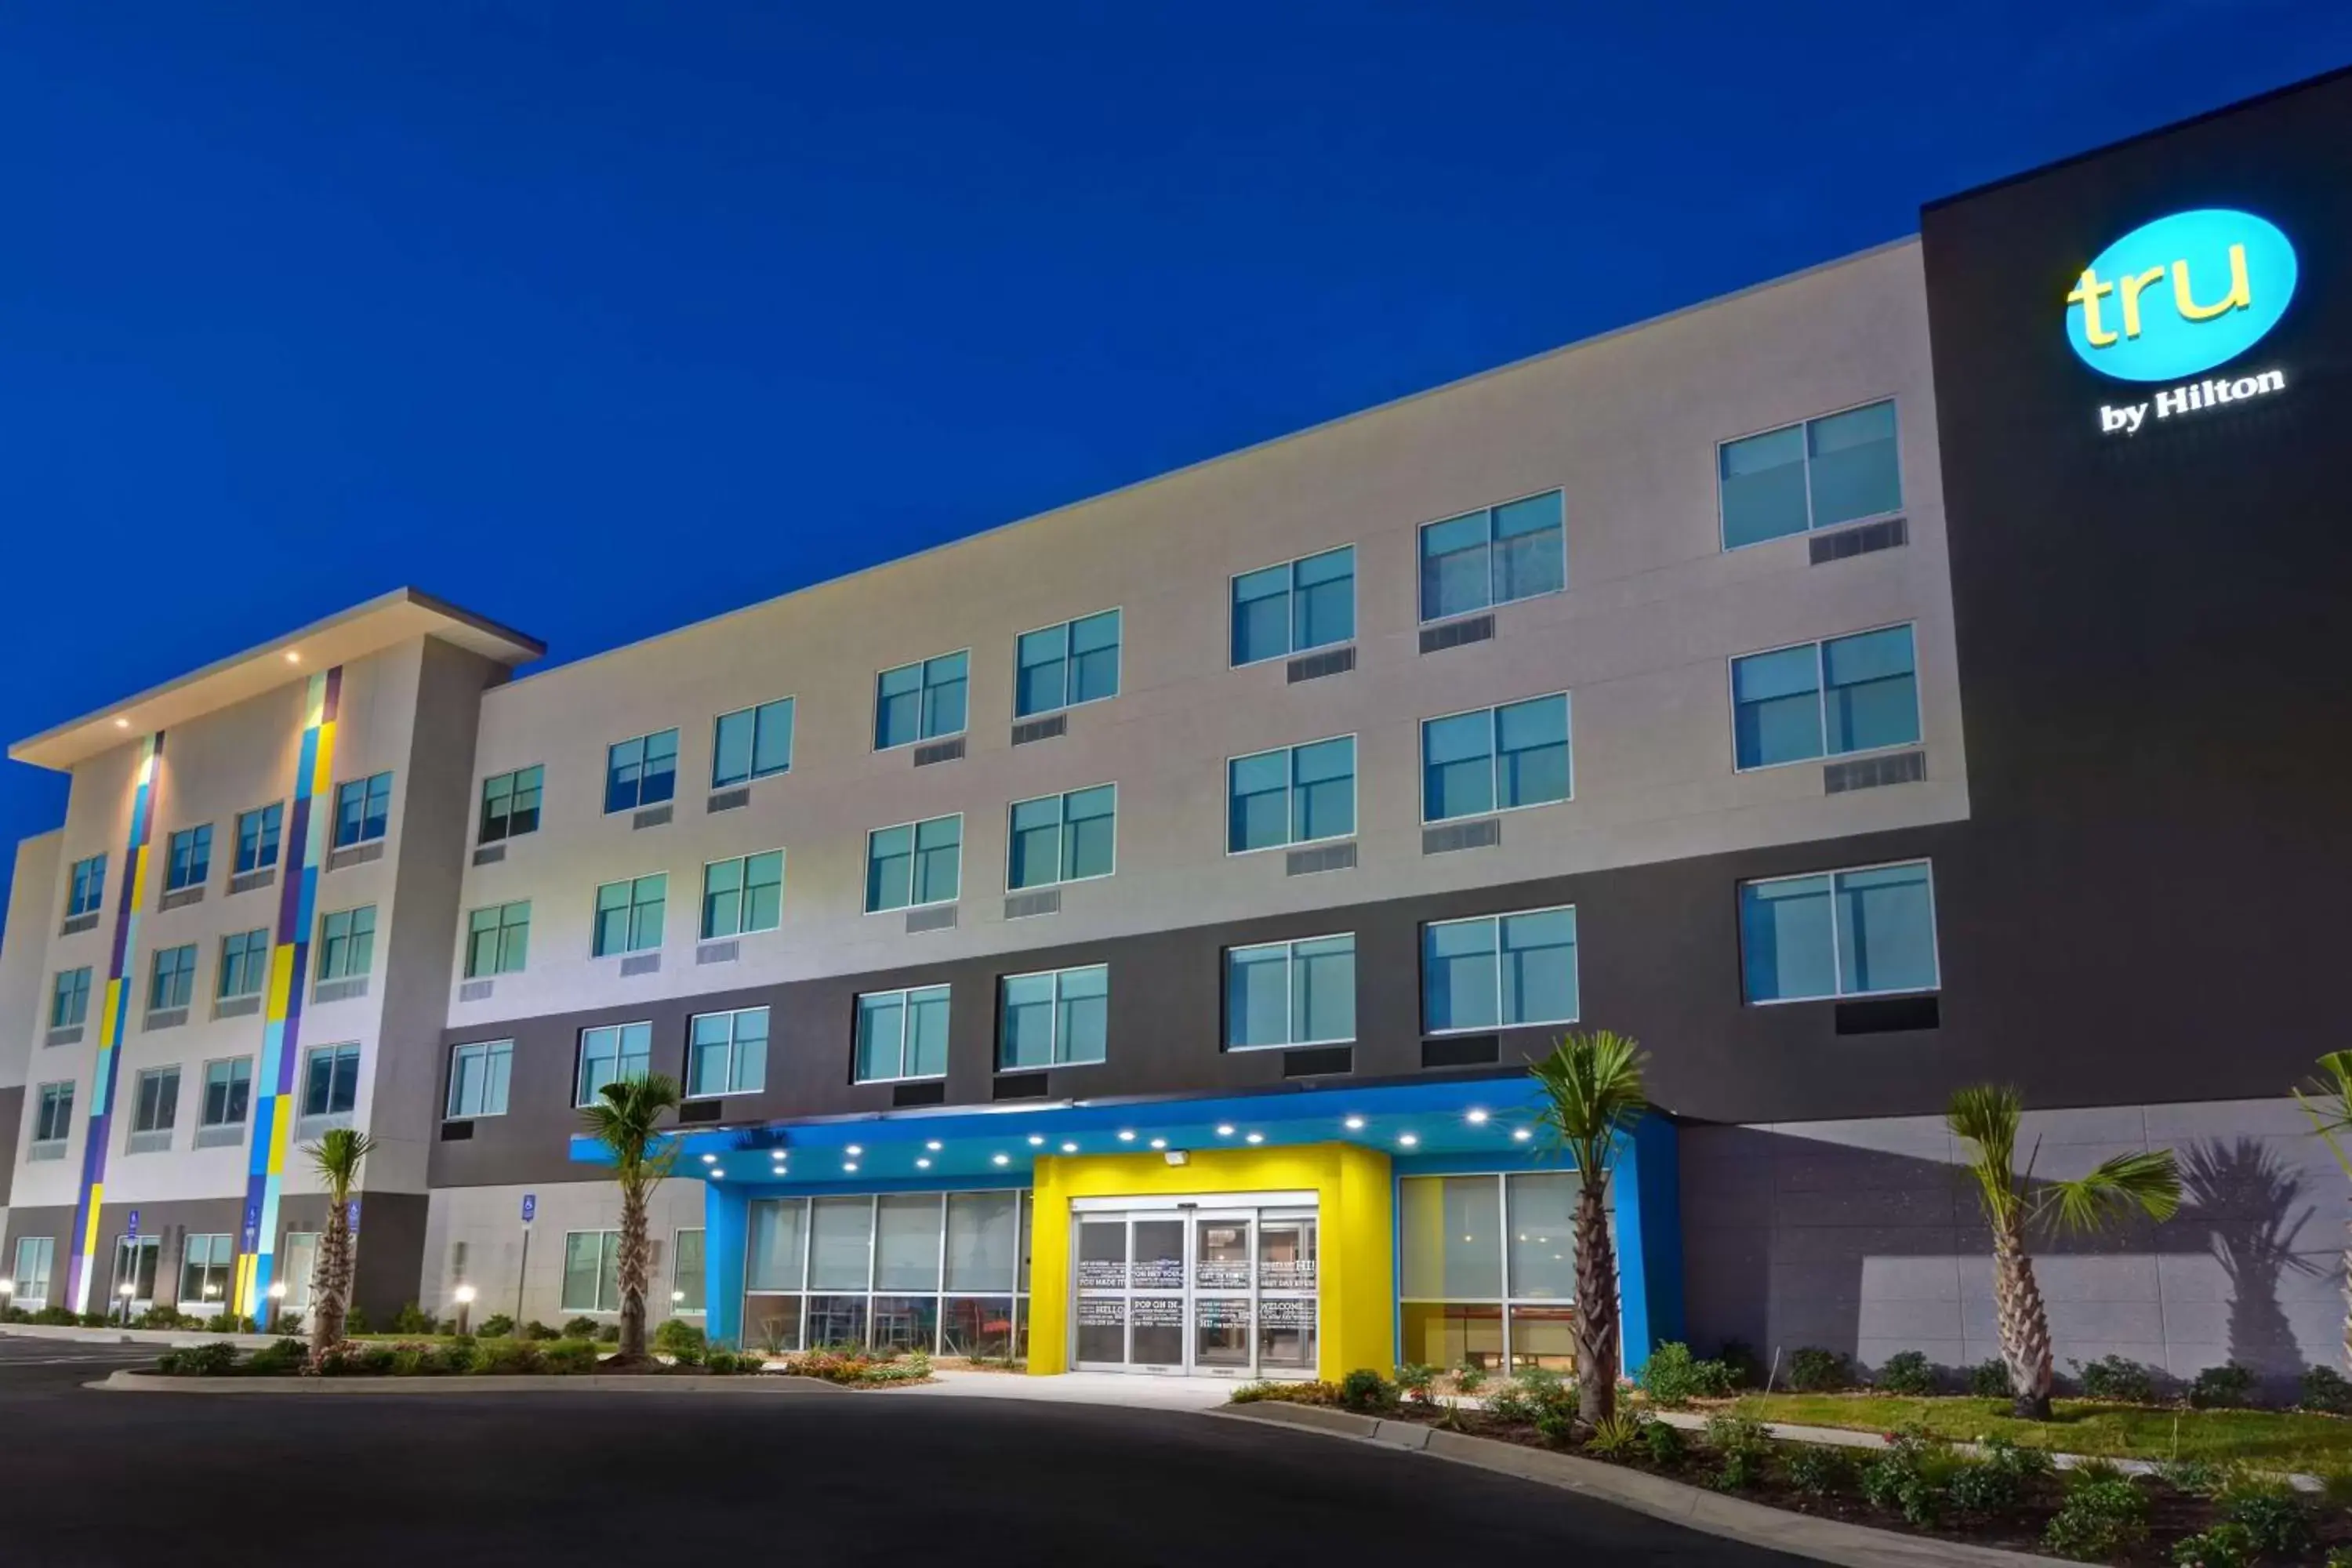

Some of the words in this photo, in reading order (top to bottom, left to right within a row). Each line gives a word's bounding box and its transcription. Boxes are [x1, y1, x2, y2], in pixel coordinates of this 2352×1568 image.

[2067, 241, 2251, 347] tru
[2100, 402, 2148, 434] by
[2155, 370, 2285, 418] Hilton
